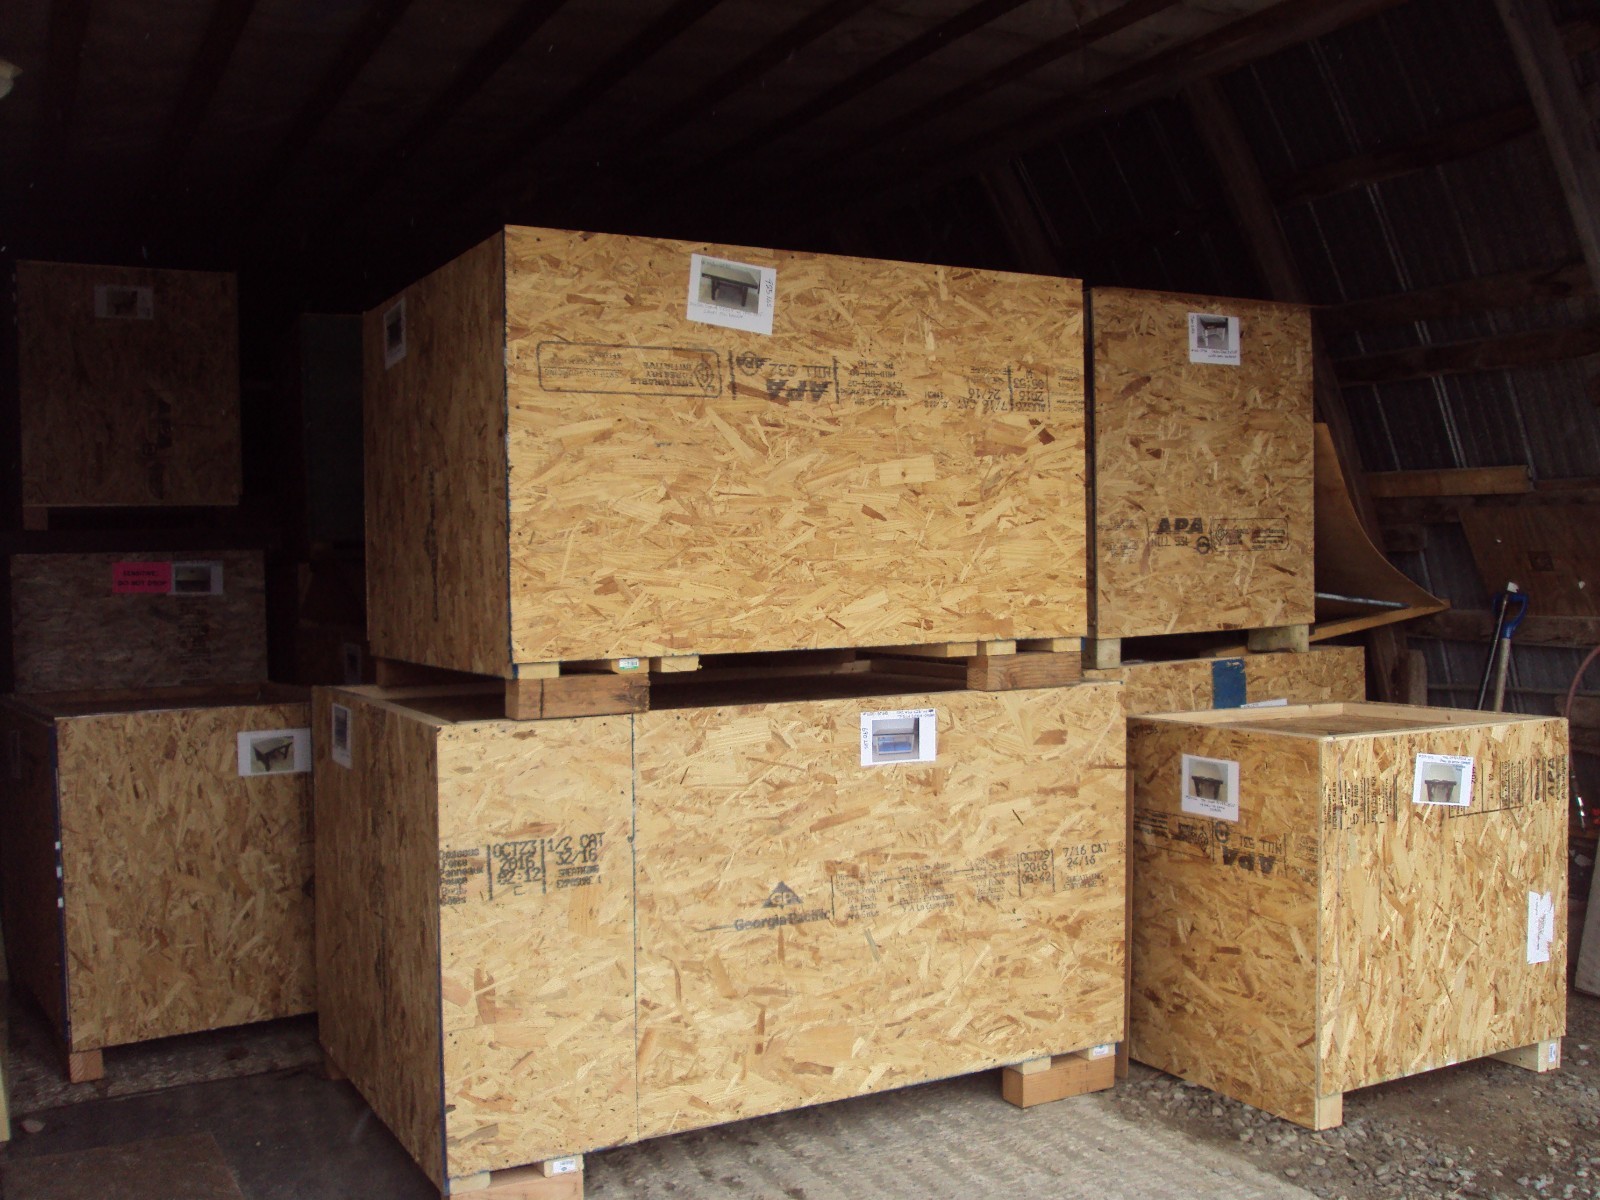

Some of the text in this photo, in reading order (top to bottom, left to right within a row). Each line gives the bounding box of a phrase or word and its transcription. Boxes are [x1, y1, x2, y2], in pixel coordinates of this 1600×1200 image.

[766, 379, 831, 402] APA
[1156, 517, 1203, 534] APA
[492, 840, 538, 858] OCT23
[547, 832, 606, 853] 1/2 CAT
[1063, 846, 1087, 858] 7/16
[1091, 842, 1109, 854] CAT
[500, 855, 535, 871] 2016
[555, 848, 598, 866] 32/16
[1020, 850, 1050, 862] OCT29
[1066, 855, 1096, 869] 24/16
[1222, 847, 1275, 875] APA
[1023, 860, 1048, 873] 2016
